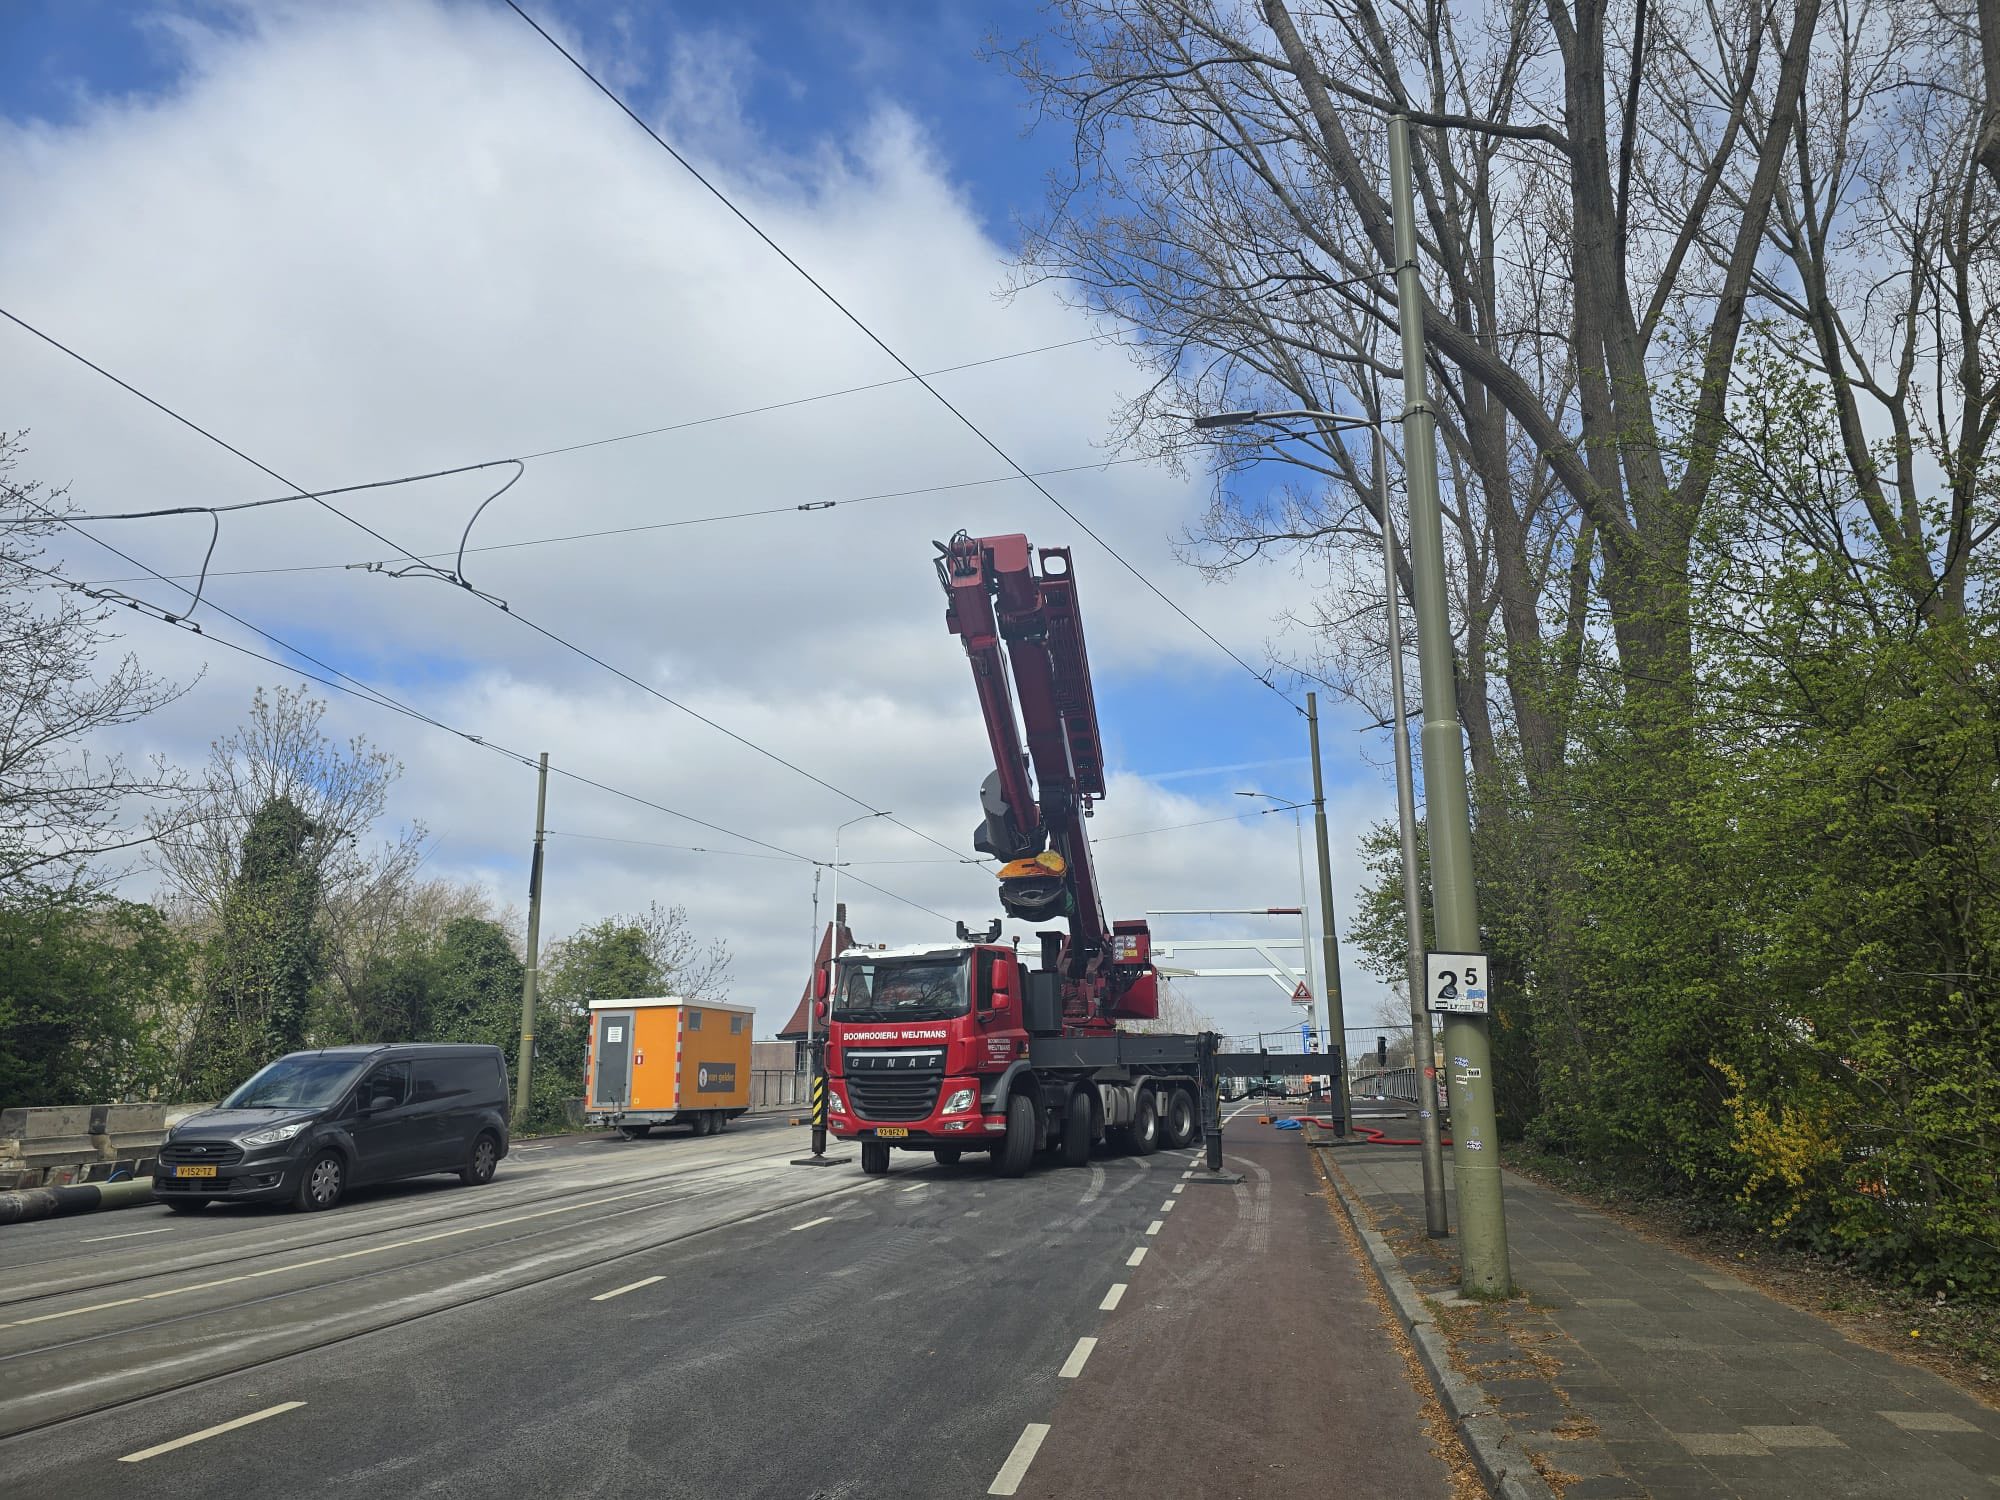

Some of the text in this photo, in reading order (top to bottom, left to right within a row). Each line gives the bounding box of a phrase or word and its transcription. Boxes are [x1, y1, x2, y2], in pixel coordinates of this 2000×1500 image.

[843, 1030, 947, 1041] BOOMROOIERIJ WEIJTMANS
[851, 1057, 936, 1068] GINAF
[180, 1167, 213, 1176] V-152-TZ
